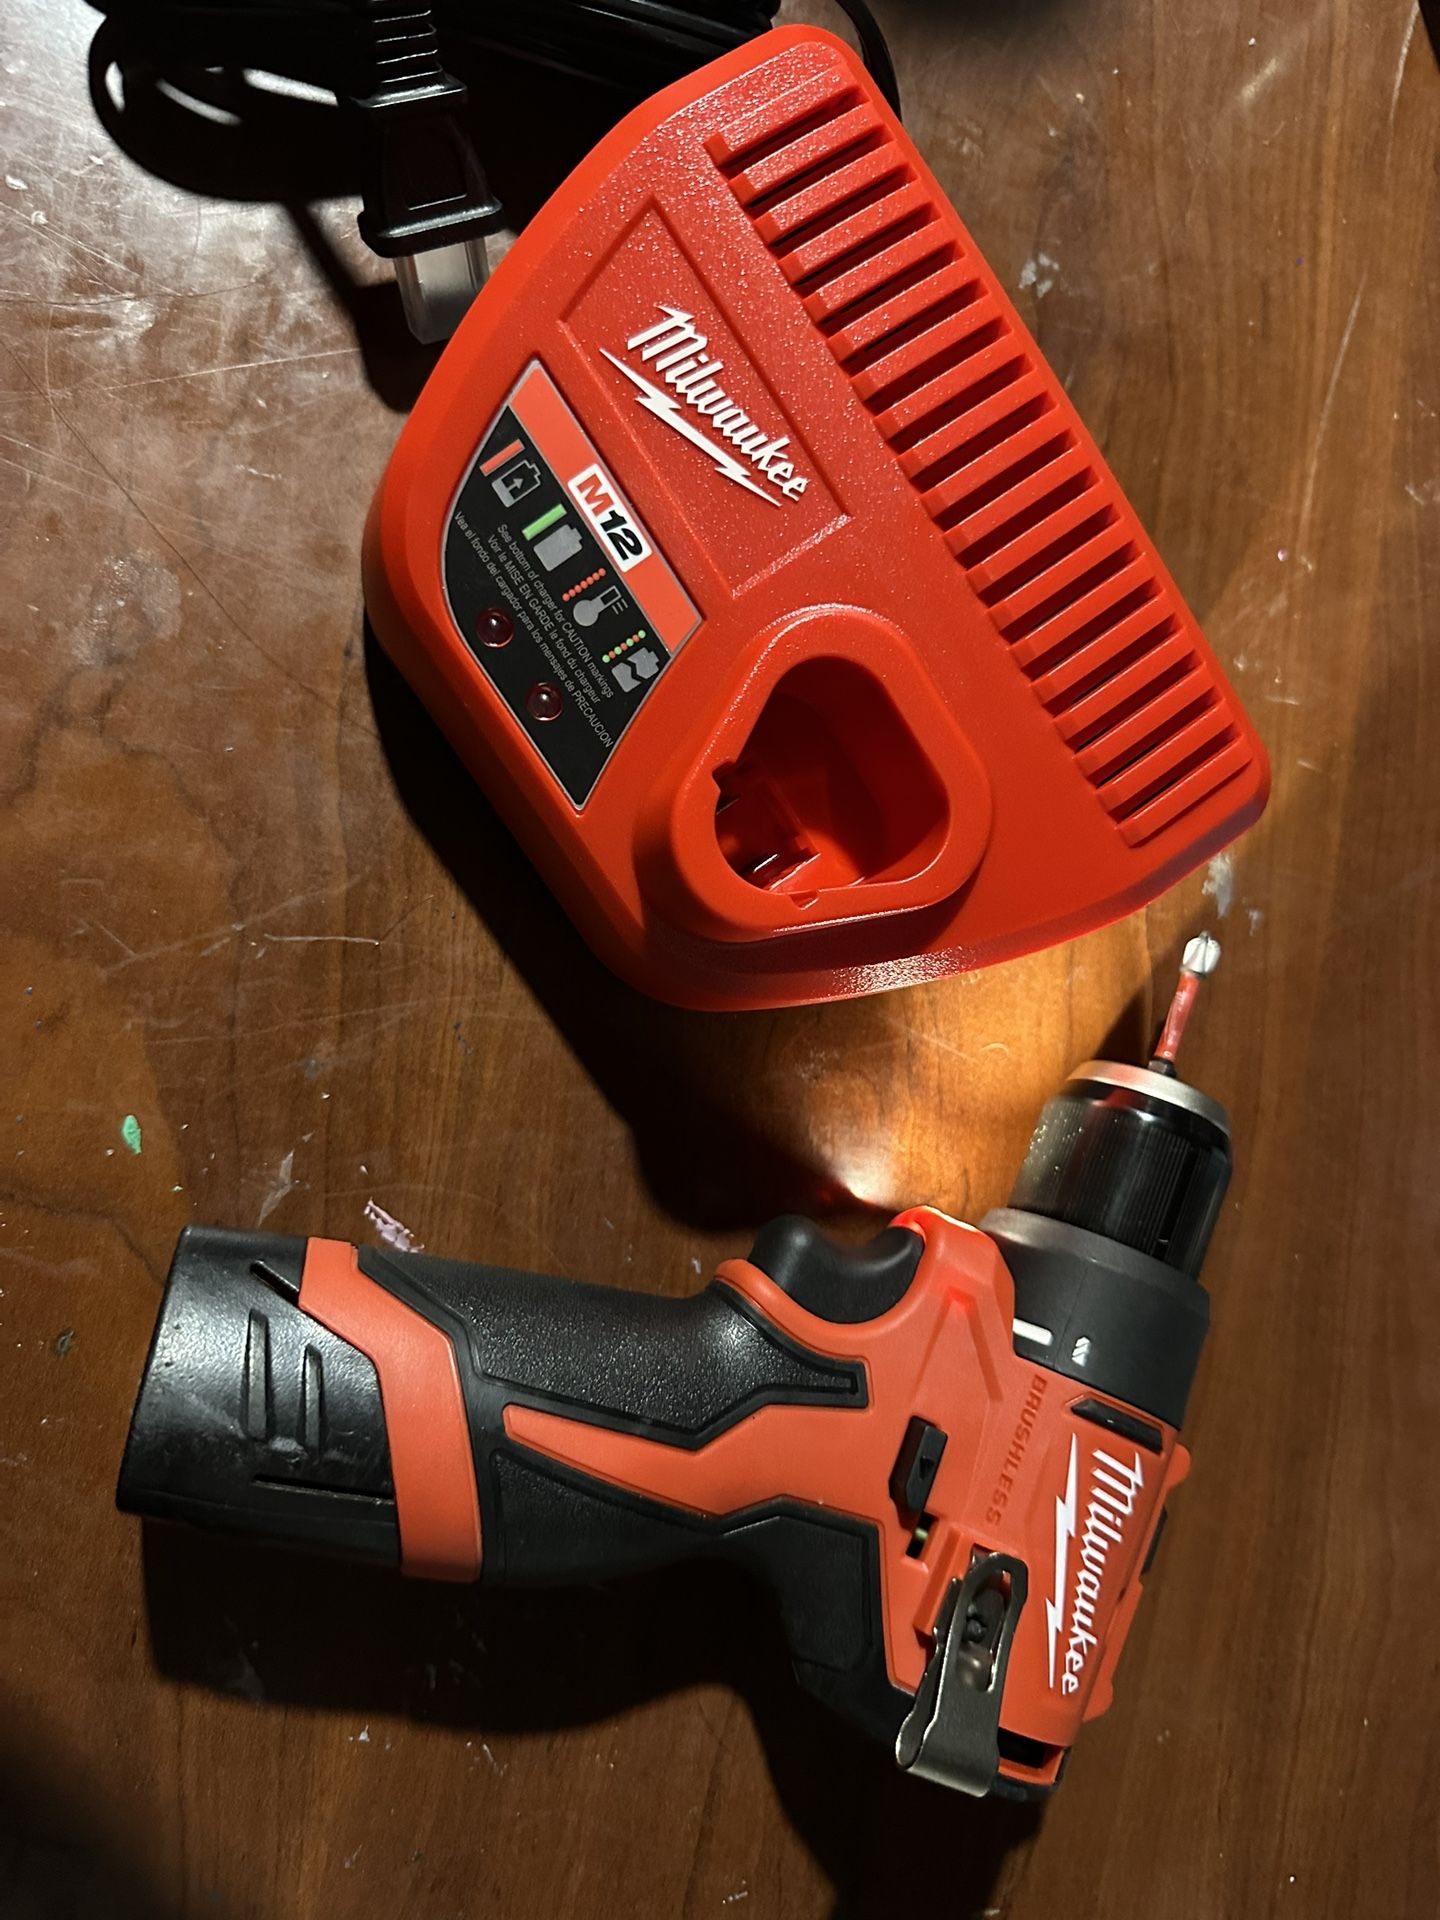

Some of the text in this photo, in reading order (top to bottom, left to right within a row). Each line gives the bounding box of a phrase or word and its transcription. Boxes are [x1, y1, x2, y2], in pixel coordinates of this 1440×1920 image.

[627, 304, 809, 501] Milwaukee
[575, 473, 643, 561] M12
[454, 511, 614, 748] Vea el fondo del cargador para los mensajes de PRECAUCION
[487, 534, 601, 704] Voir le MISE EN GARDE le fond du chargeur
[497, 523, 614, 698] See bottom of charger for CAUTION markings
[985, 1374, 1047, 1526] BRUSHLESS
[1061, 1449, 1145, 1696] Milwaukee
